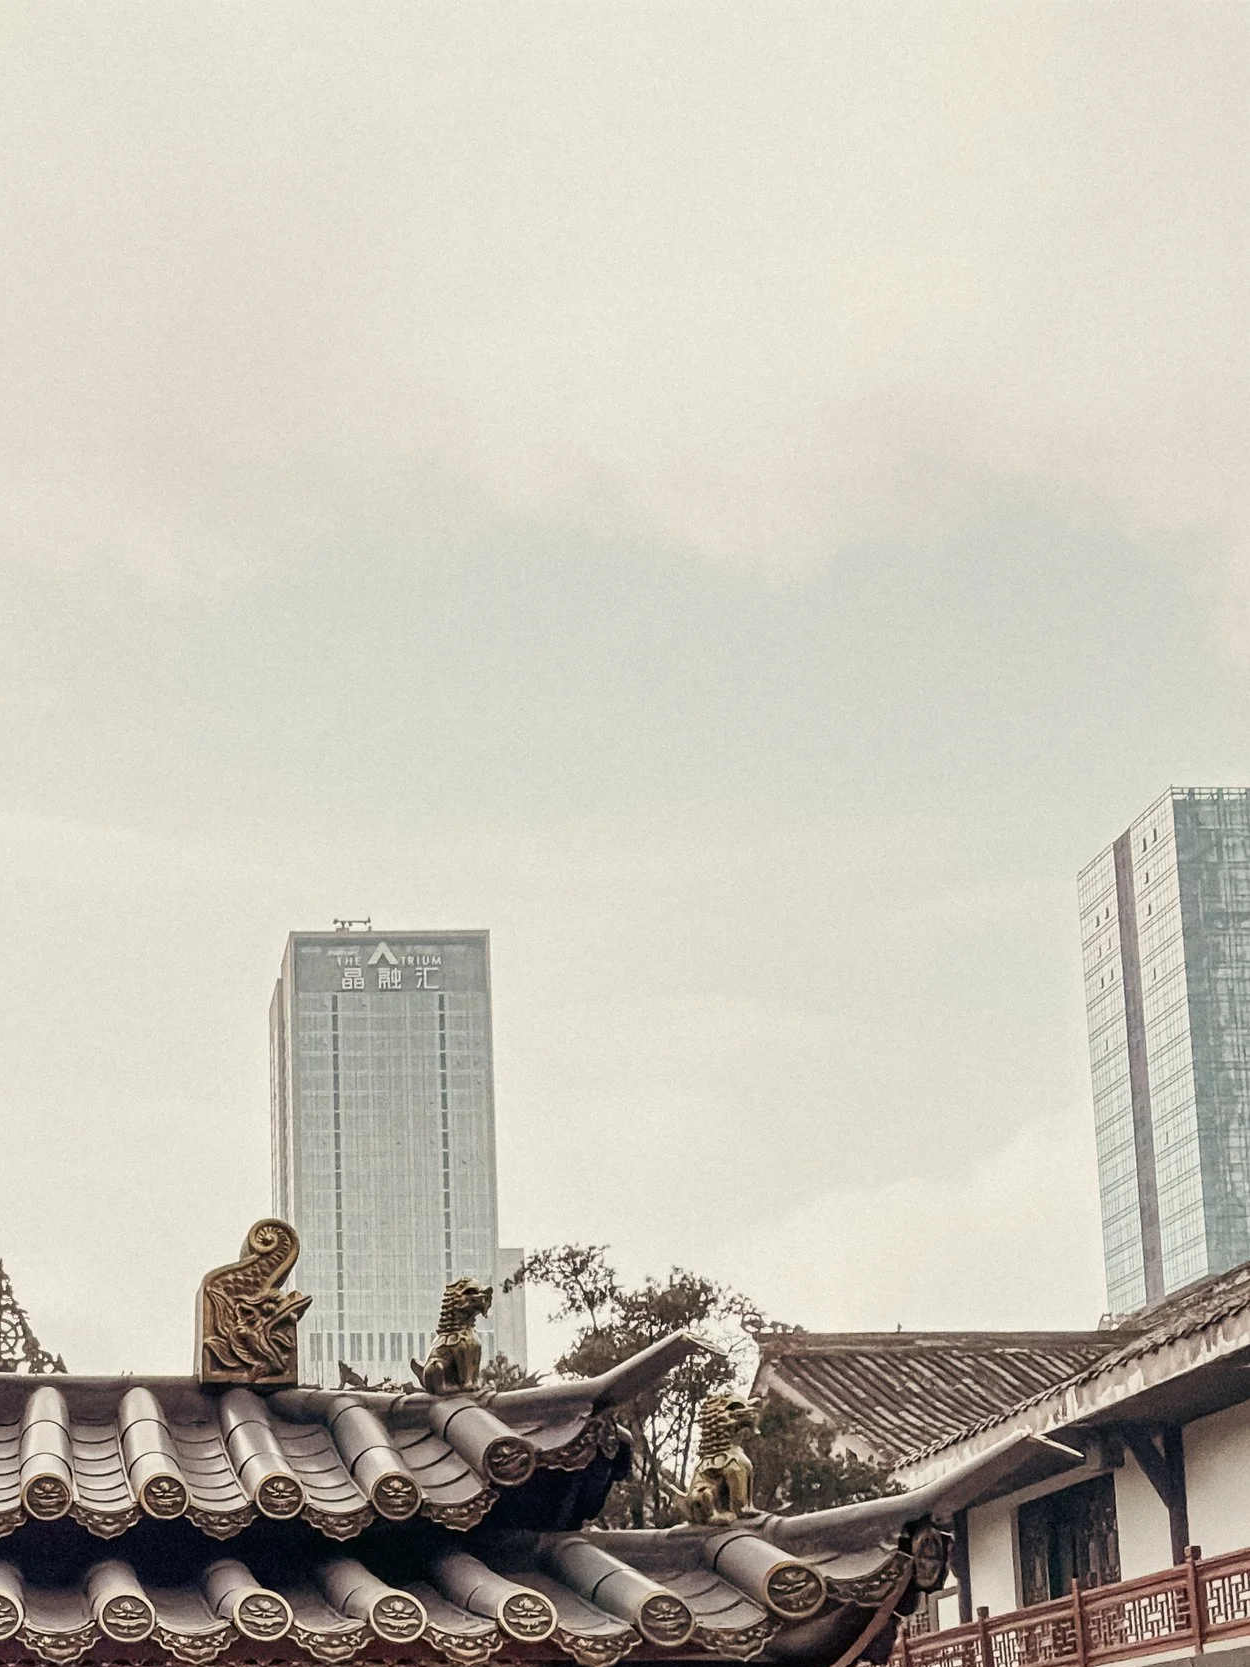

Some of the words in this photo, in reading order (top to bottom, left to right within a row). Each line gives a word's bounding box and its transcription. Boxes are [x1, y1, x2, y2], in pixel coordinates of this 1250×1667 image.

[337, 956, 361, 966] THE
[342, 967, 440, 990] 晶融汇
